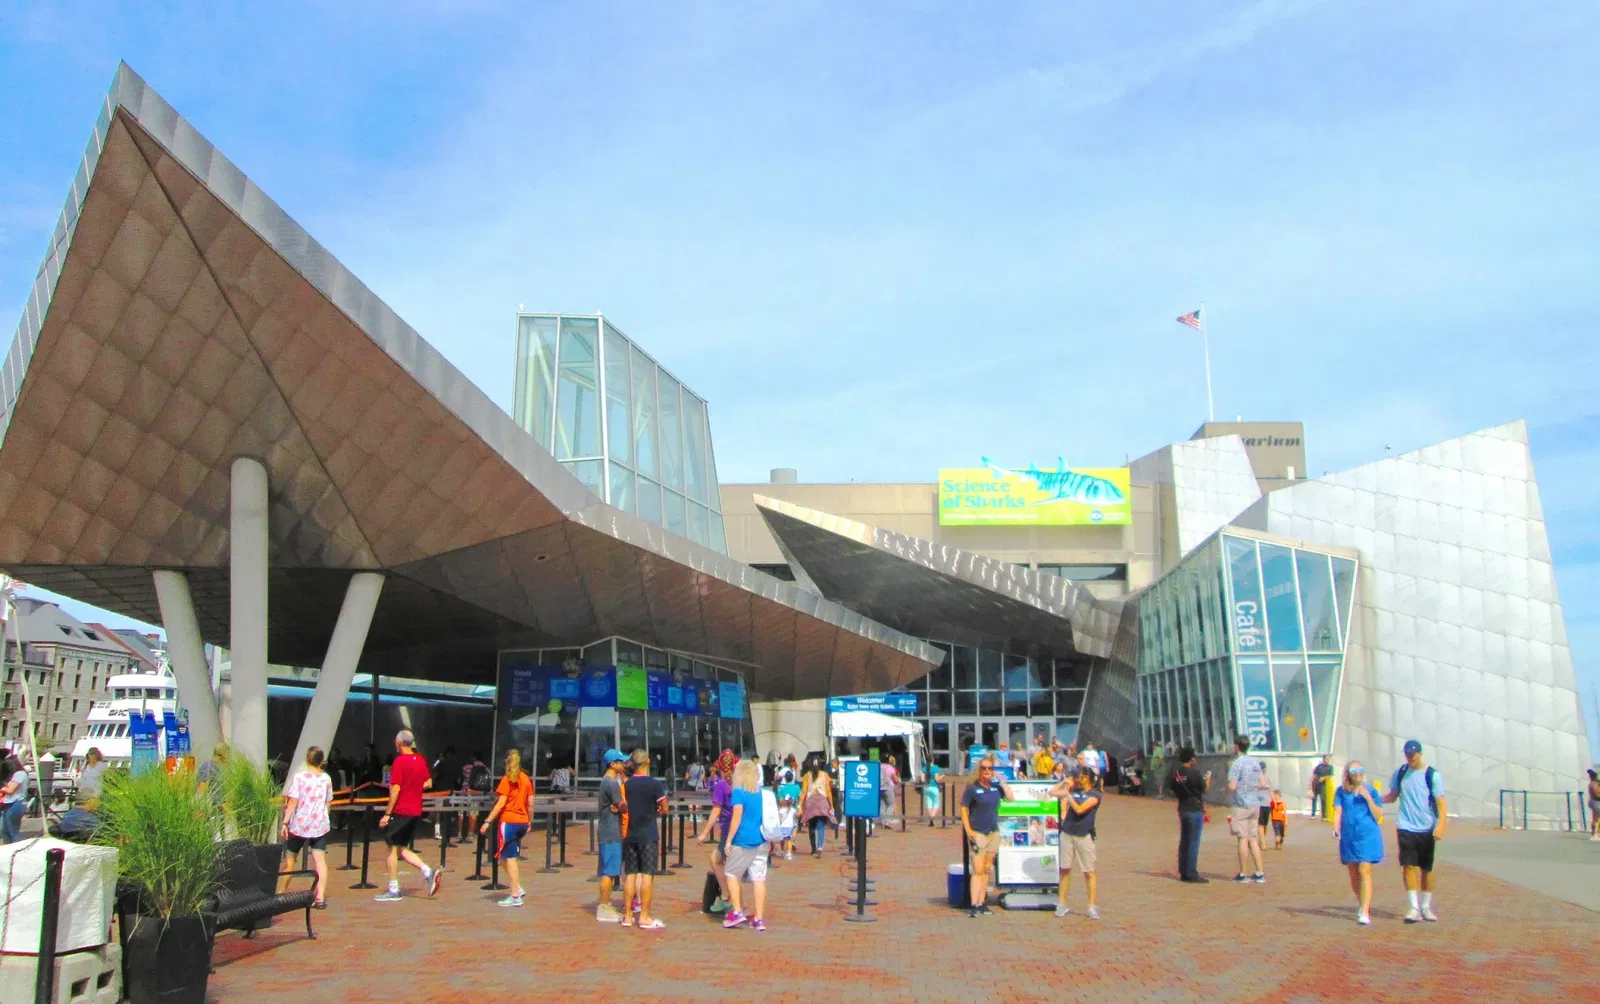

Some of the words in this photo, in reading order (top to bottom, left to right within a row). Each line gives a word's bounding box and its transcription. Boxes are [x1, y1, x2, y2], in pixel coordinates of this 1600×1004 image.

[943, 479, 1010, 493] Science
[943, 495, 961, 508] of
[964, 495, 1026, 509] Sharks
[1236, 600, 1262, 647] Café
[1245, 695, 1270, 746] Gifts
